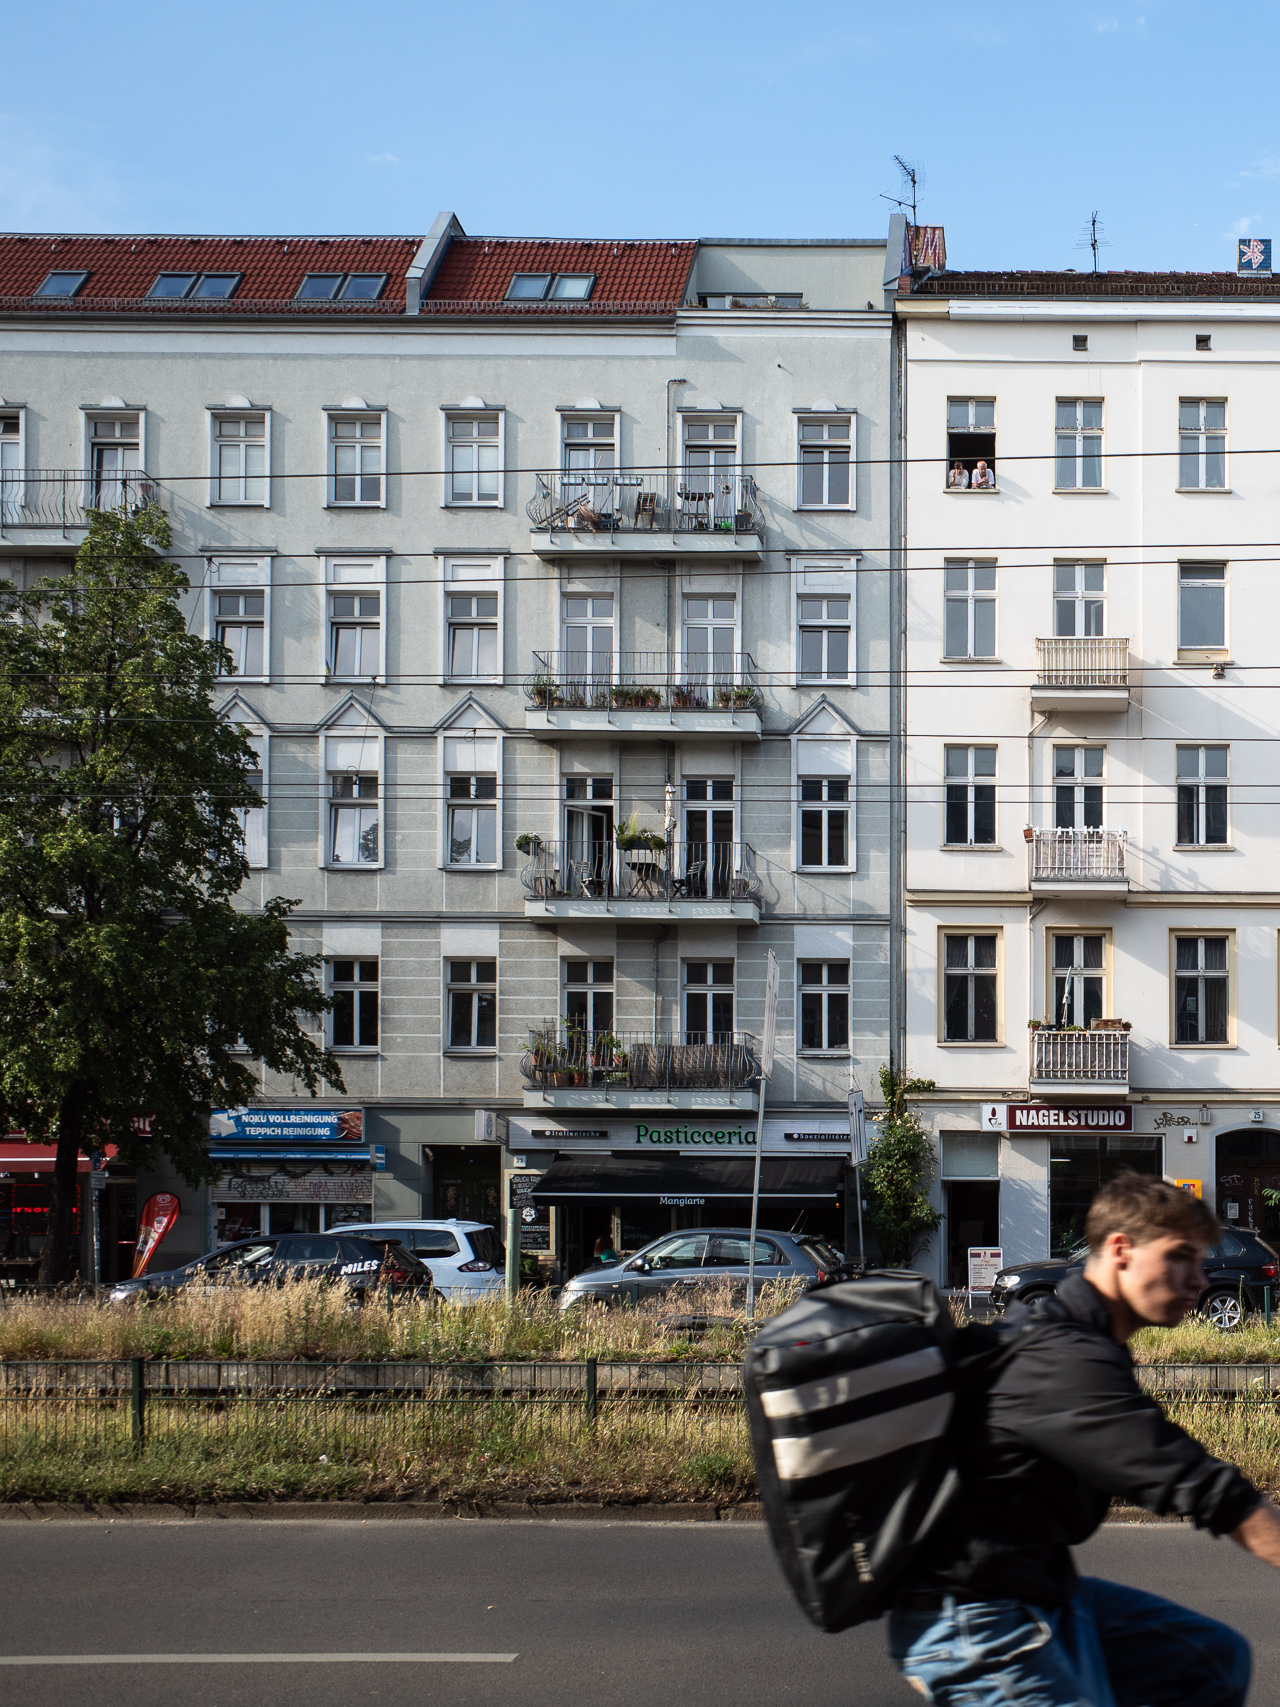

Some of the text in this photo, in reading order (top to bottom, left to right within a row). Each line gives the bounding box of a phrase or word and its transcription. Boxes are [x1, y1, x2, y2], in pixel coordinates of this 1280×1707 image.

[241, 1114, 338, 1124] NOKU VOLLREINIGUNG
[1015, 1109, 1126, 1126] NAGELSTUDIO
[1253, 1111, 1261, 1119] 25
[245, 1127, 331, 1136] TEPPICH REINIGUNG
[635, 1124, 758, 1145] Pasticceria
[659, 1197, 705, 1206] Mangiarte
[339, 1259, 380, 1275] MILES
